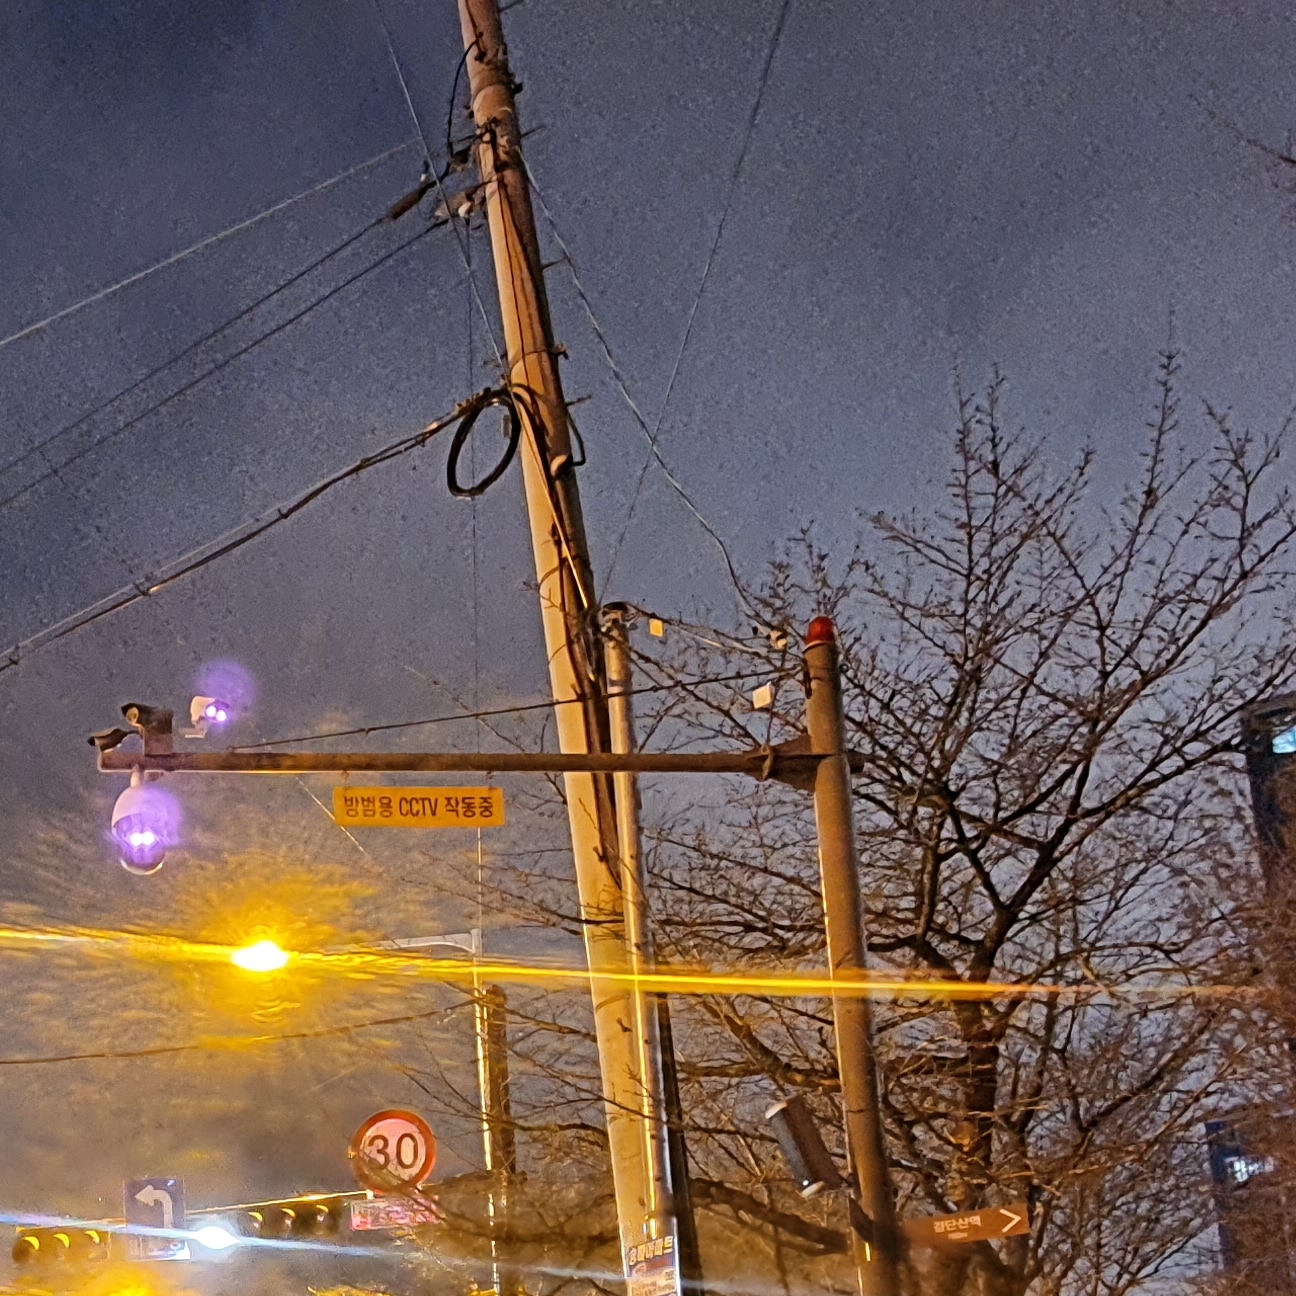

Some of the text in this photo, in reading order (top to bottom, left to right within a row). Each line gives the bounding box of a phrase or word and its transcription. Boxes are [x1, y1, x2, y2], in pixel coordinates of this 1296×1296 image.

[344, 796, 494, 818] 방범용 CCTV 작동중
[368, 1133, 419, 1169] 30
[933, 1215, 982, 1234] 검단산역
